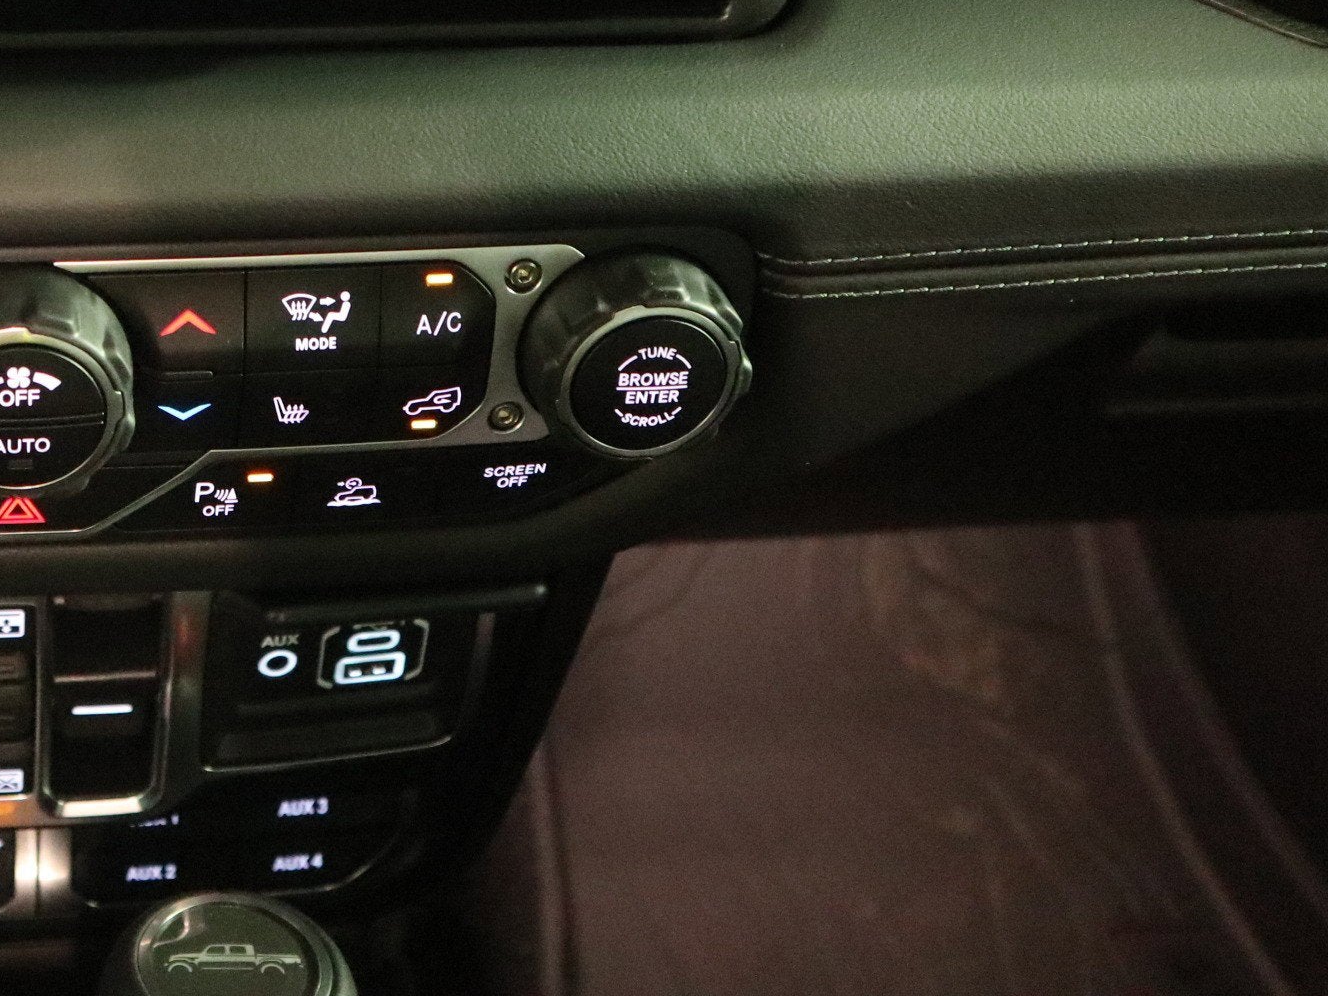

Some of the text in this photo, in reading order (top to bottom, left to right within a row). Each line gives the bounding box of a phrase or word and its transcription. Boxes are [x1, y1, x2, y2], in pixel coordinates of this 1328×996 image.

[416, 312, 462, 336] A/C
[295, 337, 337, 352] MODE
[638, 346, 677, 360] TUNE
[618, 371, 690, 387] BROWSE
[625, 390, 680, 405] ENTER
[621, 412, 675, 427] SCROLL
[483, 463, 546, 478] SCREEN
[496, 475, 529, 489] OFF
[202, 504, 235, 517] OFF
[261, 635, 300, 649] AUX
[277, 797, 329, 817] AUX 3
[273, 853, 323, 872] AUX 4
[126, 863, 177, 882] AUX 2
